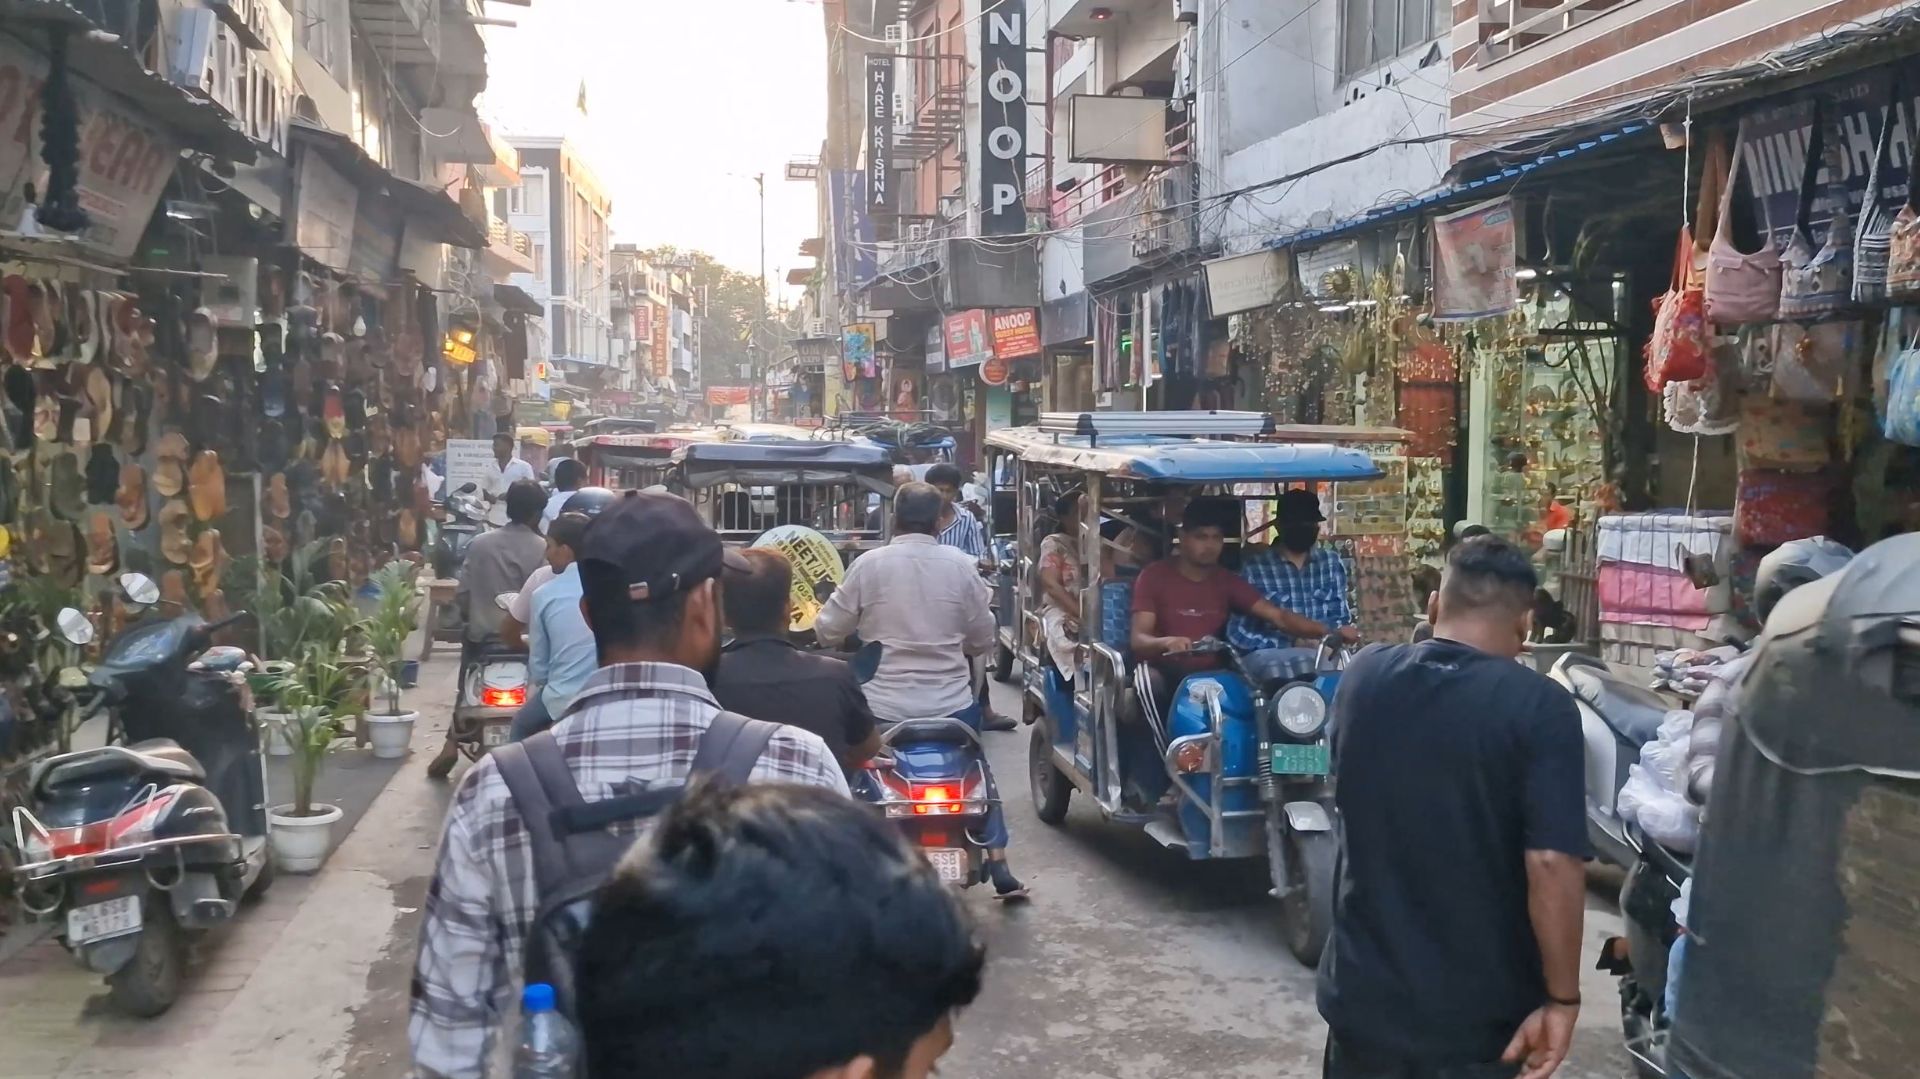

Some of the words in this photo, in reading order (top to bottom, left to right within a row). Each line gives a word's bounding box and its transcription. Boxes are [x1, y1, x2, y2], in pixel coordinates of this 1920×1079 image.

[874, 71, 885, 117] HARE
[874, 125, 885, 205] KRISHNA
[995, 312, 1032, 331] ANOOP
